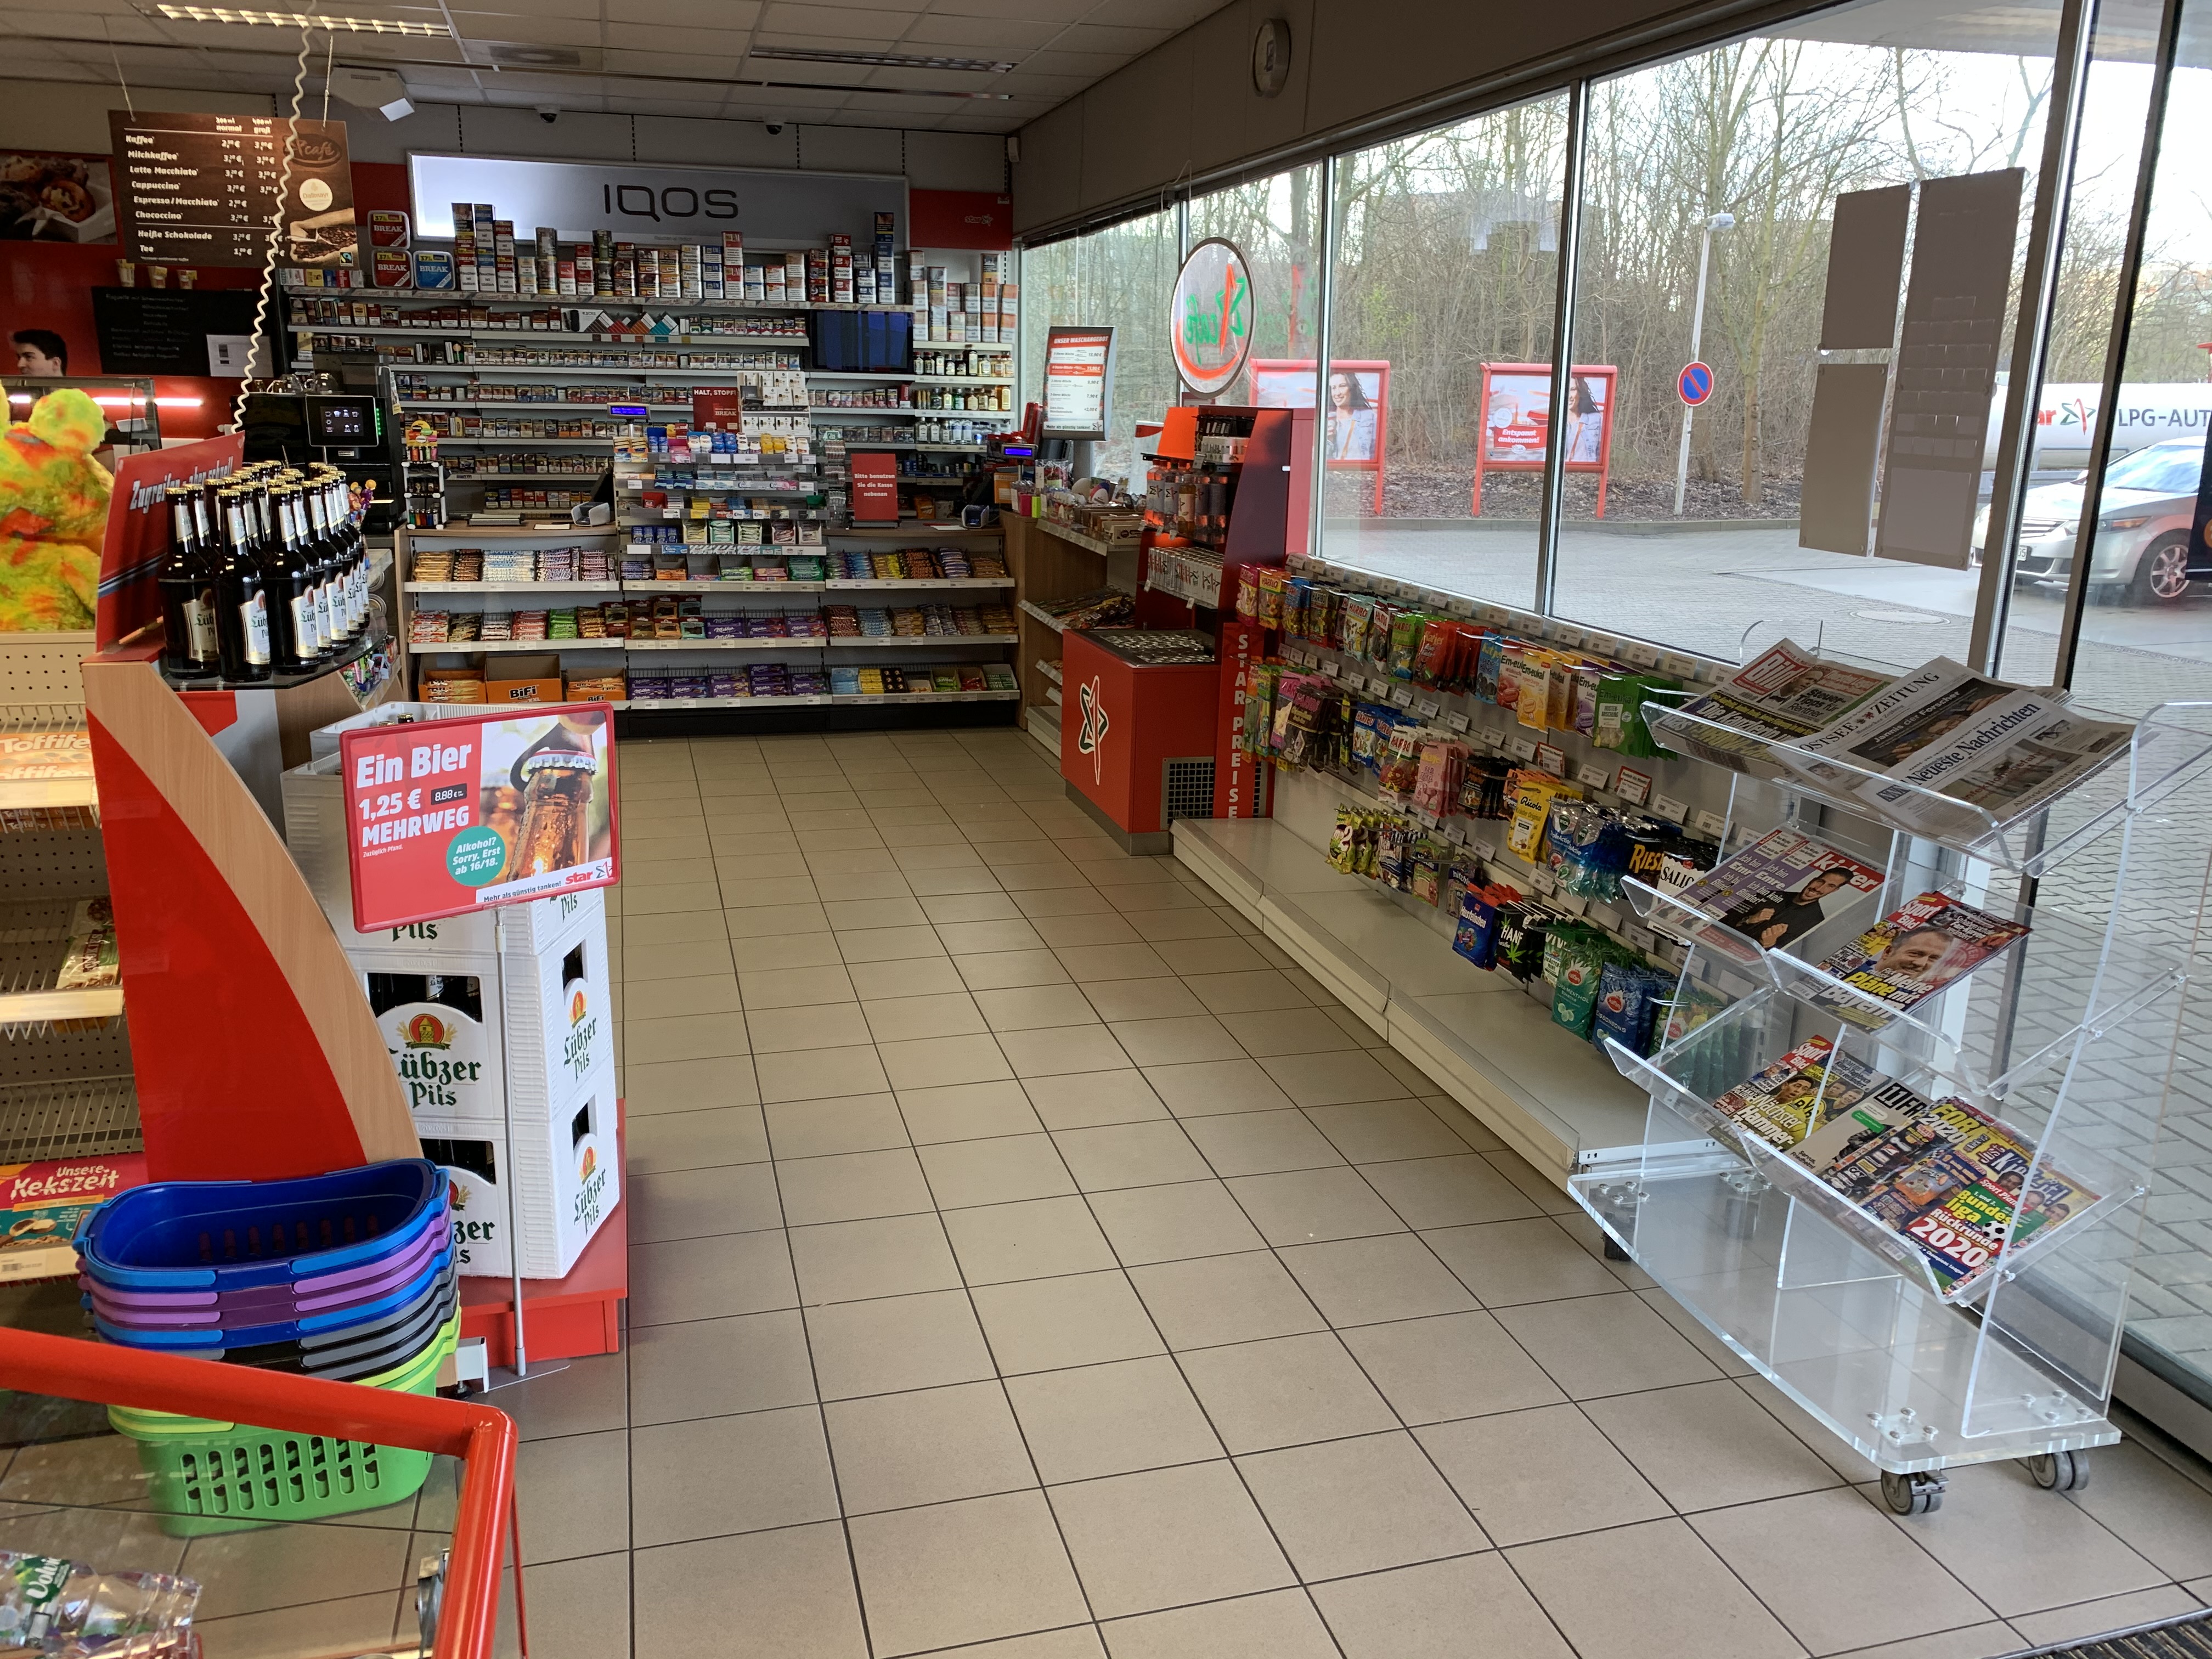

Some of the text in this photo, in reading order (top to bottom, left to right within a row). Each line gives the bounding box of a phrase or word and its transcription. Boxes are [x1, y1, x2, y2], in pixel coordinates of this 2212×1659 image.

[604, 183, 739, 223] IQOS
[138, 230, 212, 240] Heiße Schokolade
[374, 224, 403, 233] BREAK
[1070, 335, 1109, 343] WASCHANGEBOT
[2118, 408, 2210, 427] LPG-AUT
[1502, 429, 1537, 437] Entspannt
[129, 456, 234, 514] Zugreifen aber schnell
[1262, 578, 1278, 589] HARIBO
[1349, 603, 1368, 618] HARIBO
[1234, 634, 1249, 705] STAR
[1522, 664, 1545, 680] Em-eukal
[1743, 657, 1804, 689] Bild
[509, 685, 537, 699] BiFi
[1599, 689, 1634, 704] Em-eukal
[1808, 688, 1847, 704] Steuer-
[1788, 702, 1822, 718] Rentner
[1795, 693, 1842, 713] Tipps für
[1799, 722, 1859, 752] OSTSEE
[1870, 673, 1940, 715] ZEITUNG
[1356, 712, 1375, 726] HARIBO
[1699, 701, 1726, 718] Die
[1719, 710, 1780, 742] Kanzlerin
[1875, 690, 1960, 744] Jannis der Forscher
[1391, 737, 1413, 752] HARIBO
[1912, 749, 1965, 786] Neueste
[1961, 703, 2041, 758] Nachrichten
[357, 743, 472, 789] Ein Bier
[1228, 716, 1244, 819] PREISE
[2013, 764, 2084, 808] Abstrichzentrum
[358, 792, 403, 822] 1,25
[407, 788, 422, 809] €
[1520, 796, 1543, 812] Ricola
[362, 805, 470, 848] MEHRWEG
[1527, 811, 1542, 822] Original
[362, 844, 404, 858] Zuzüglich Pfand.
[455, 837, 497, 854] Alkohol?
[452, 847, 501, 867] Sorry. Erst
[455, 857, 499, 876] ab 16/18.
[1749, 858, 1761, 868] bin
[1722, 872, 1734, 882] Ich
[1775, 868, 1789, 878] bin
[1813, 854, 1879, 890] kier
[483, 894, 501, 902] Mehr
[512, 885, 537, 898] günstig
[537, 881, 562, 893] tanken!
[565, 870, 594, 885] star
[1746, 881, 1784, 904] Ich bin kein
[561, 893, 578, 923] Pils
[1899, 899, 1943, 920] Sport
[1897, 913, 1921, 930] Bild
[392, 923, 438, 943] Pils
[1501, 926, 1524, 946] HANF
[1843, 971, 1921, 1005] Pläne mit
[1884, 970, 1935, 995] Meine
[563, 1017, 597, 1069] Lübzer
[1793, 1042, 1831, 1061] Sport
[574, 1052, 590, 1084] Pils
[1789, 1055, 1810, 1070] Bild
[409, 1080, 457, 1109] Pils
[1755, 1093, 1802, 1129] Nächster
[1737, 1104, 1795, 1145] Hammer-
[1920, 1113, 1968, 1144] 2020
[1799, 1150, 1817, 1164] Servus,
[1977, 1143, 2006, 1165] Just
[57, 1165, 104, 1177] Unsere
[10, 1170, 120, 1200] Kekszeit
[1978, 1179, 2004, 1195] Sport
[574, 1168, 606, 1226] Lübzer
[1978, 1193, 1990, 1203] und
[1945, 1197, 1982, 1223] liga
[583, 1204, 600, 1238] Pils
[1929, 1207, 2000, 1252] Rückrunde
[1910, 1216, 1990, 1269] 2020
[1925, 1249, 1951, 1266] Champions
